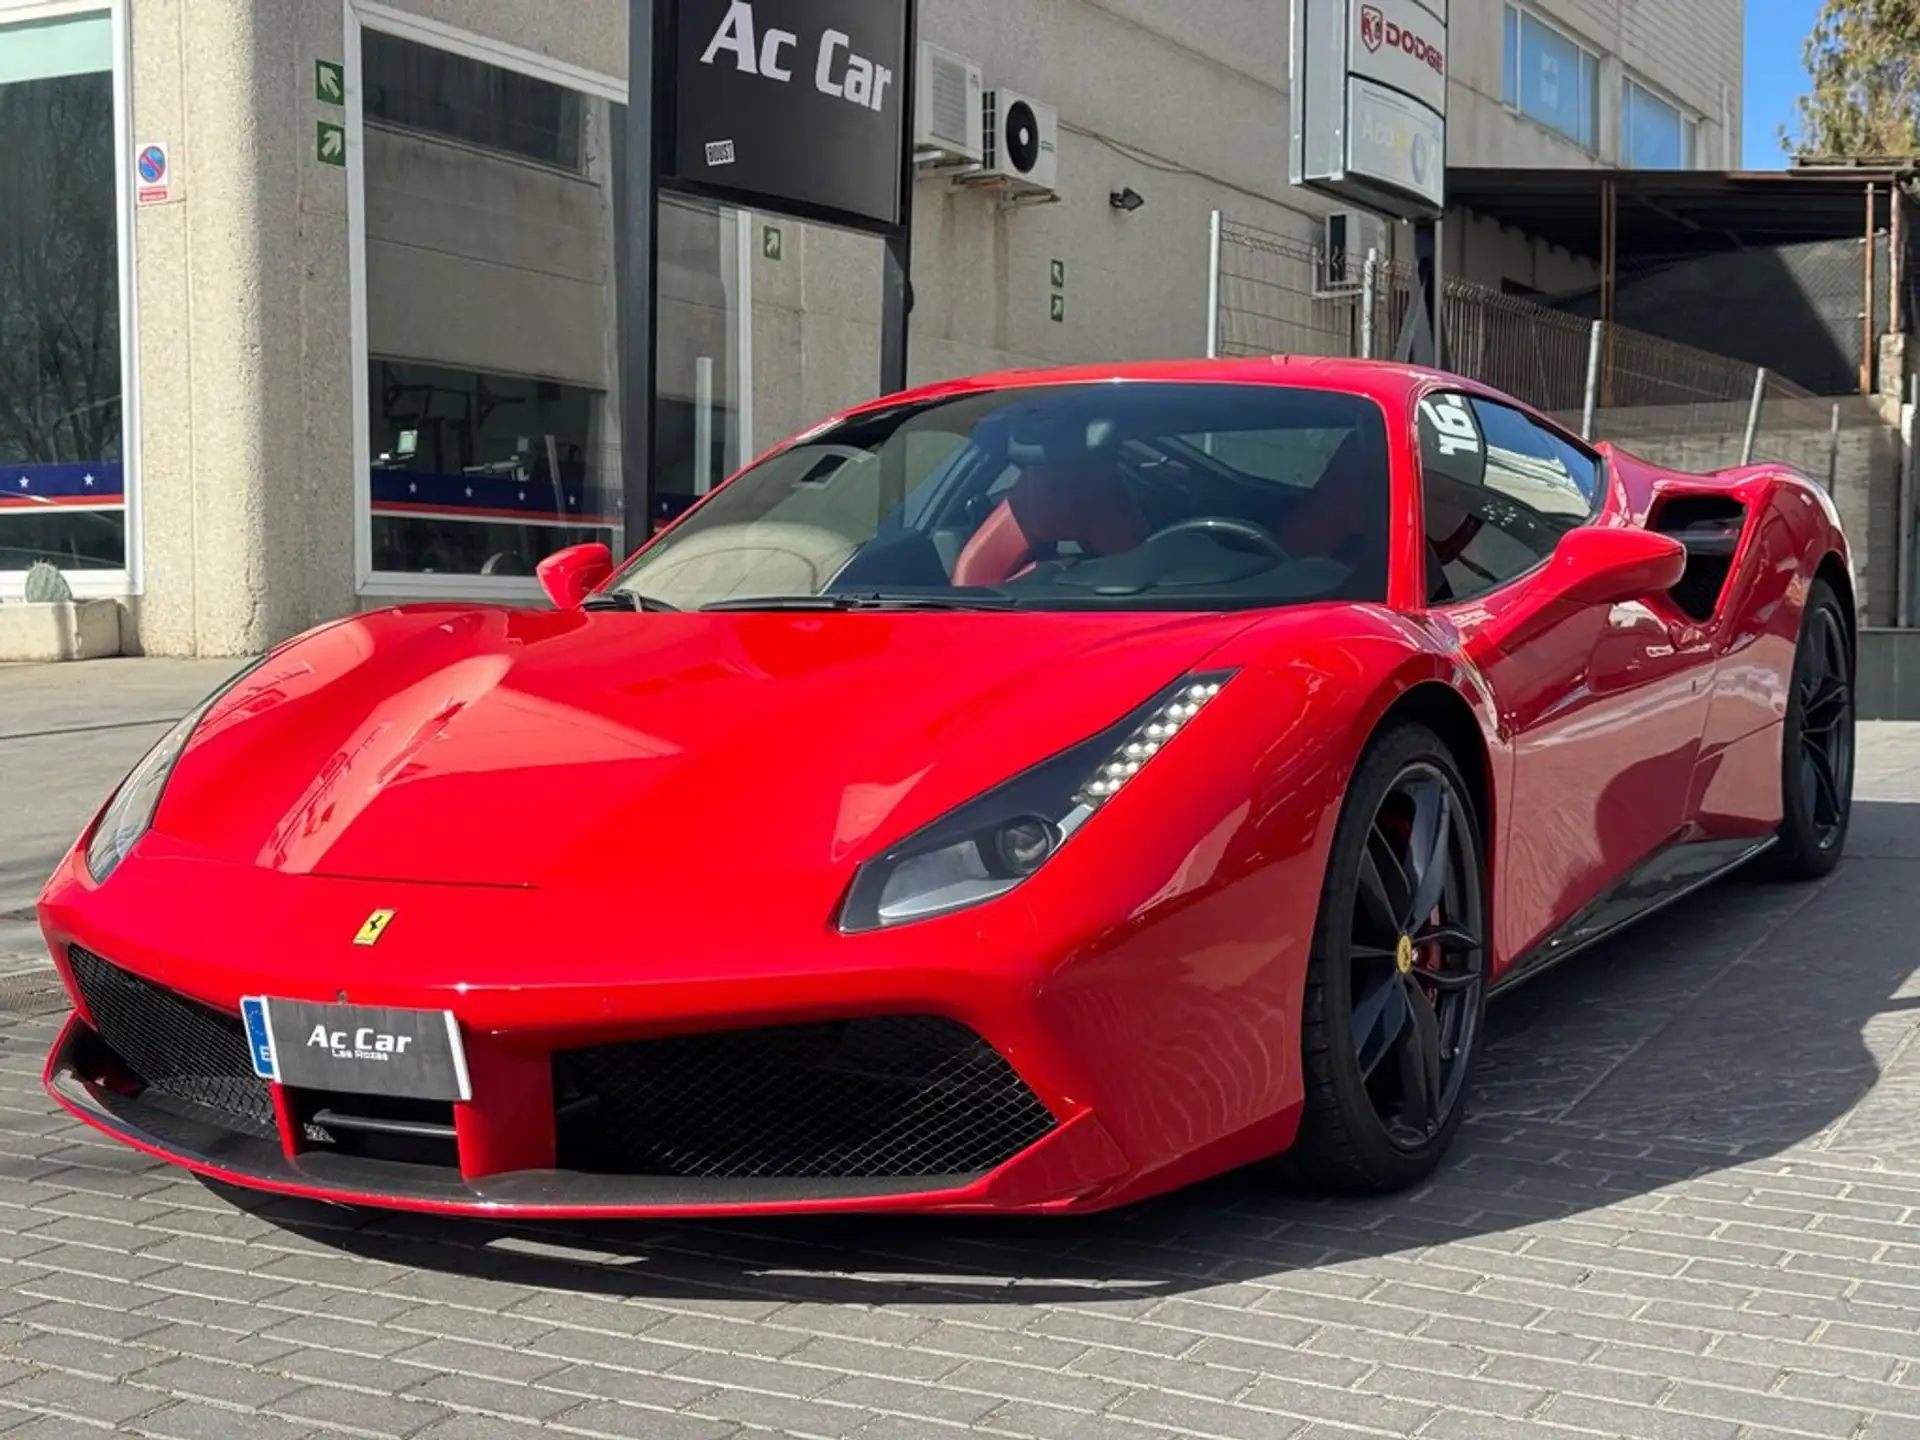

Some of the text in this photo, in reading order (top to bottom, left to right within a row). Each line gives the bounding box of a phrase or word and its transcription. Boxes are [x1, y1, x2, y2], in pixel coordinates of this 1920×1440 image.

[700, 0, 892, 112] Ac Car
[1385, 20, 1444, 76] DODGE
[259, 1045, 272, 1062] E
[307, 1024, 412, 1053] Ac Car
